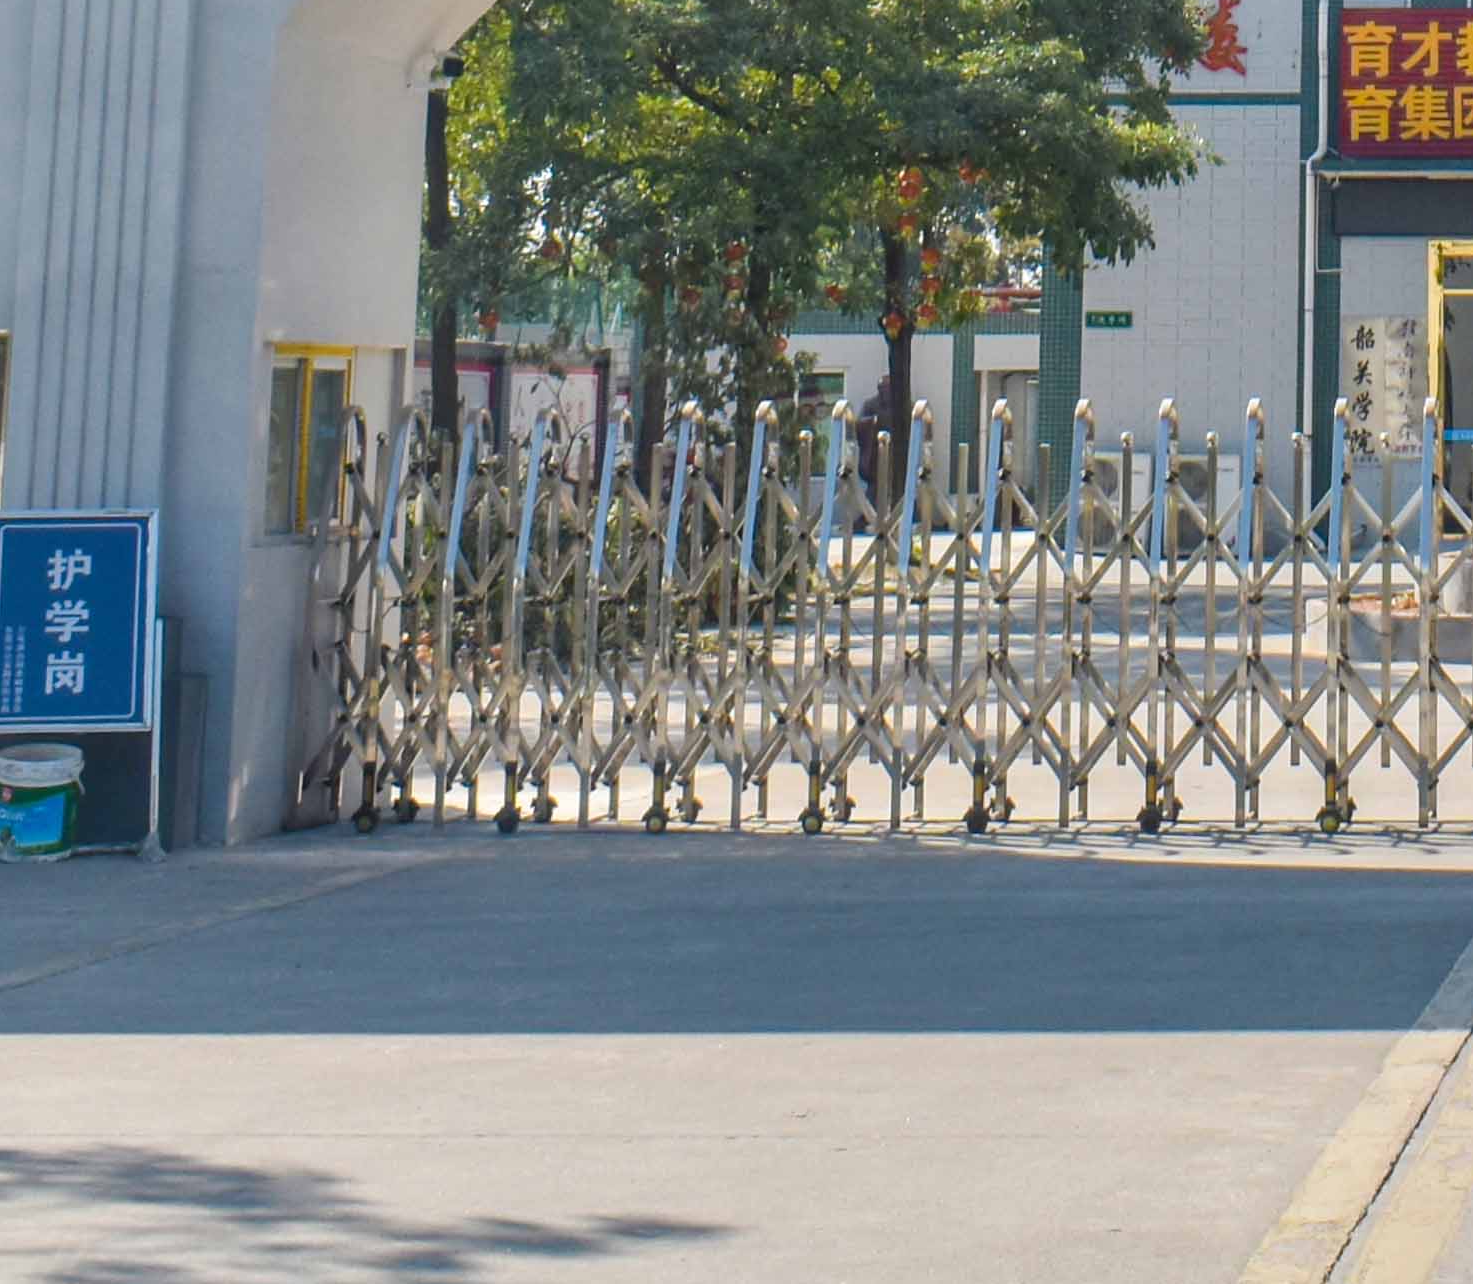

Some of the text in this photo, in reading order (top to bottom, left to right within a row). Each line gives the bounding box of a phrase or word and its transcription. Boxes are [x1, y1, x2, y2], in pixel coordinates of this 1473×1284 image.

[1349, 324, 1376, 455] 韶关学院
[44, 548, 93, 696] 护学岗
